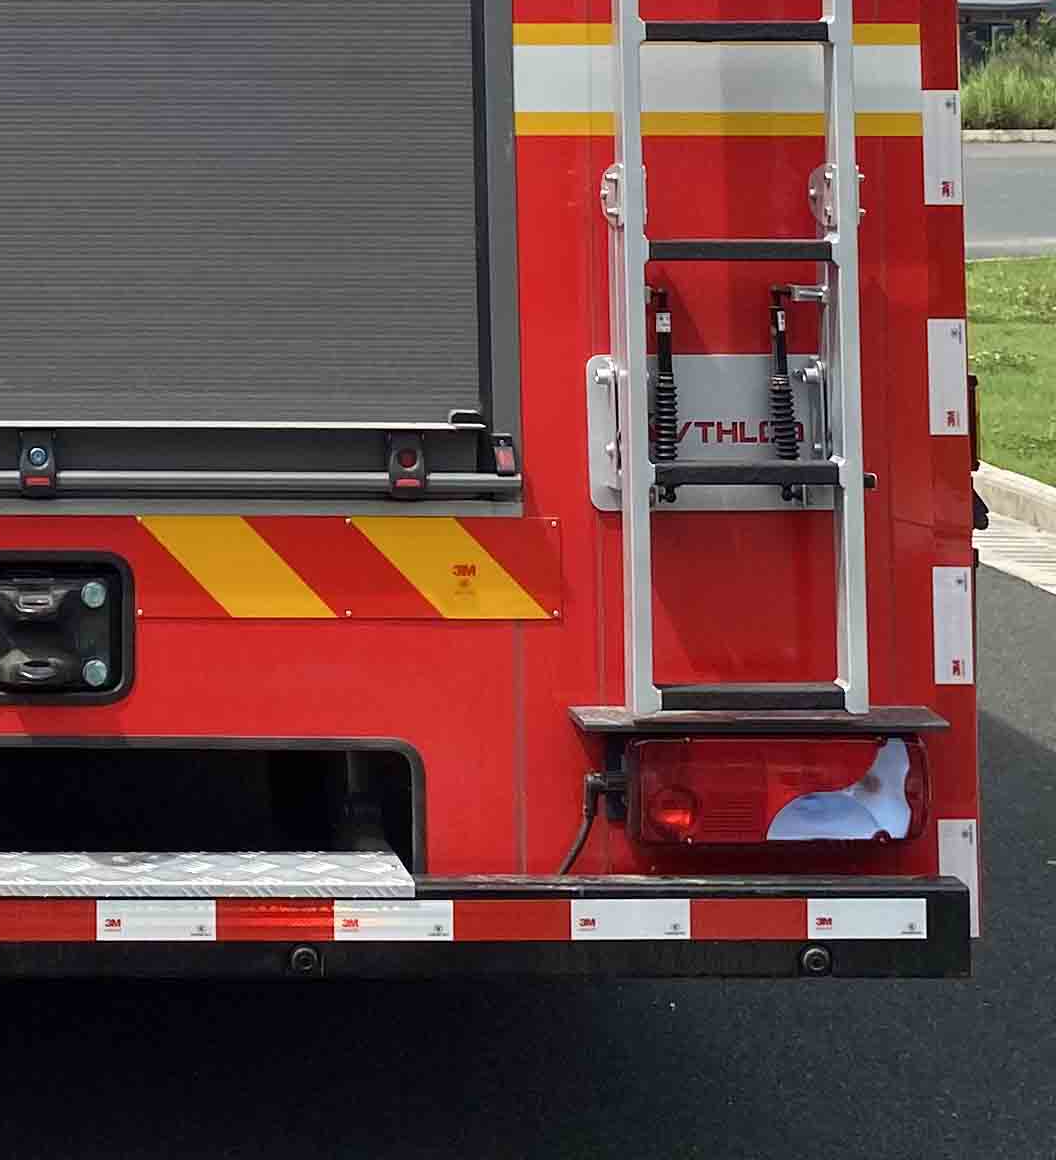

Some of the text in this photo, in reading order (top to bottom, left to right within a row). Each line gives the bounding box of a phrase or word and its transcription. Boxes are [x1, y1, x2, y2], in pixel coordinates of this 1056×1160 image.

[453, 564, 476, 576] 3M
[104, 918, 121, 928] 3M
[342, 918, 359, 928] 3M
[578, 918, 595, 927] 3M
[816, 917, 832, 926] 3M
